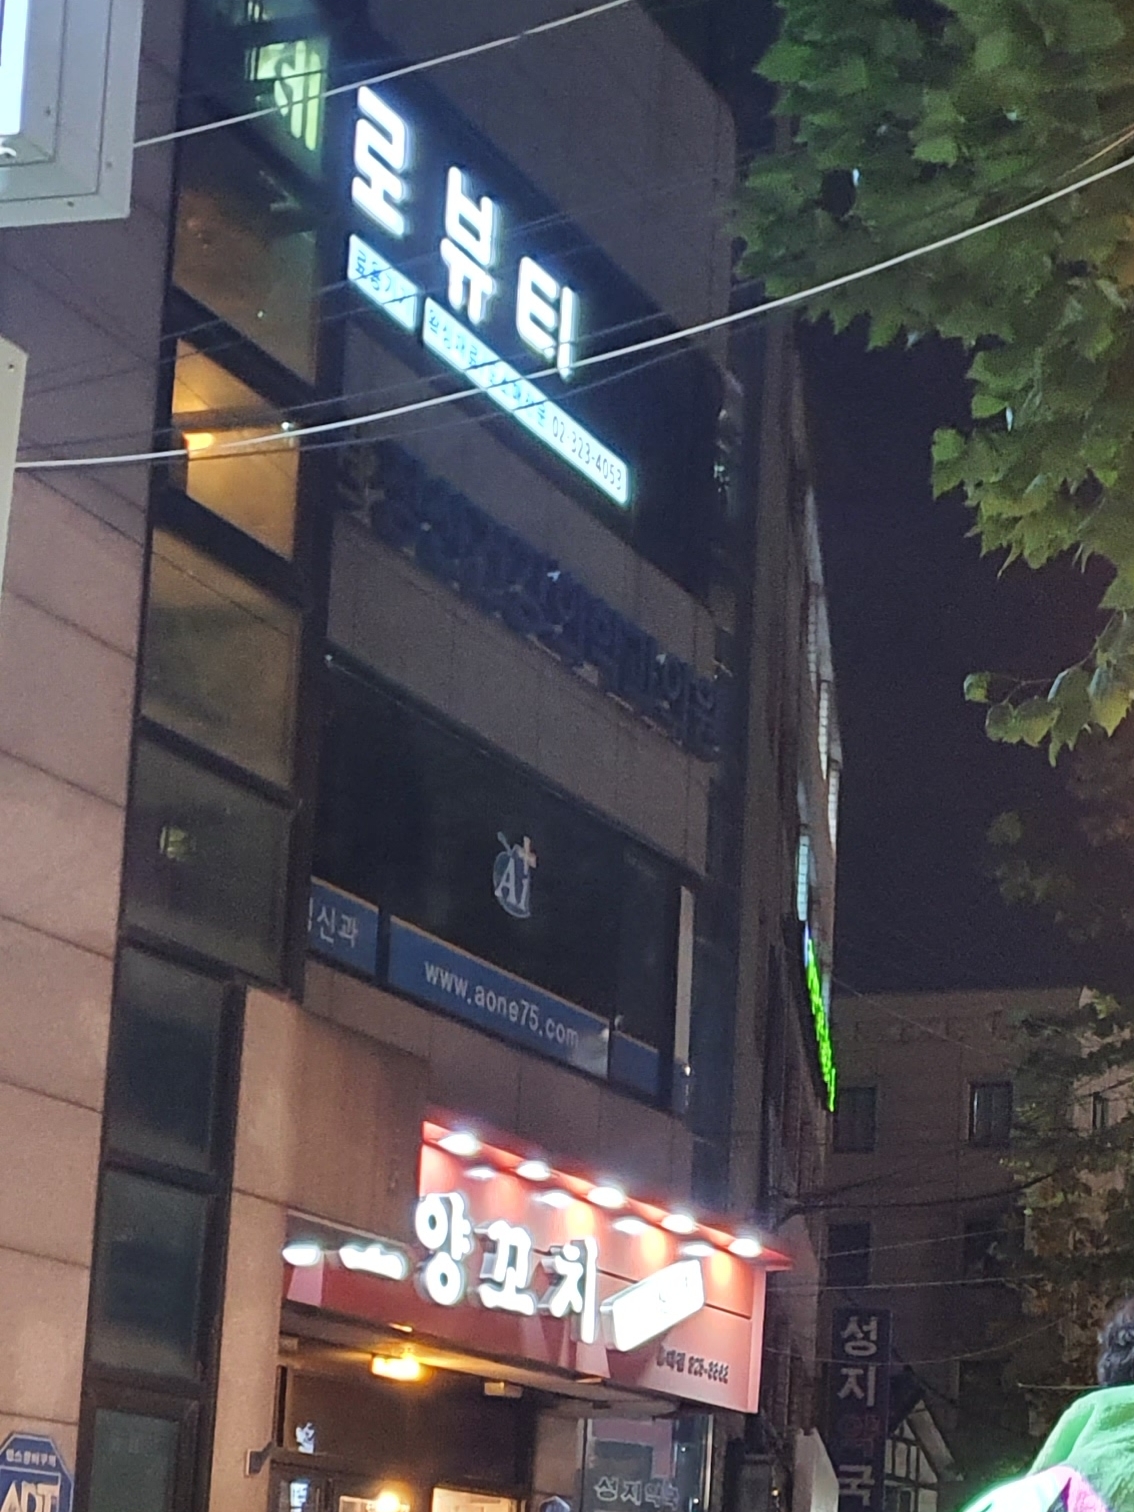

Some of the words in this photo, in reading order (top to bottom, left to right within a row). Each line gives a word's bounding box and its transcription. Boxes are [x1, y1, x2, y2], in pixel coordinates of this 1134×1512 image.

[552, 415, 623, 491] 02-323-4053
[307, 896, 359, 949] 신과
[424, 960, 580, 1048] www.aone75.com
[414, 1191, 599, 1345] 양꼬치
